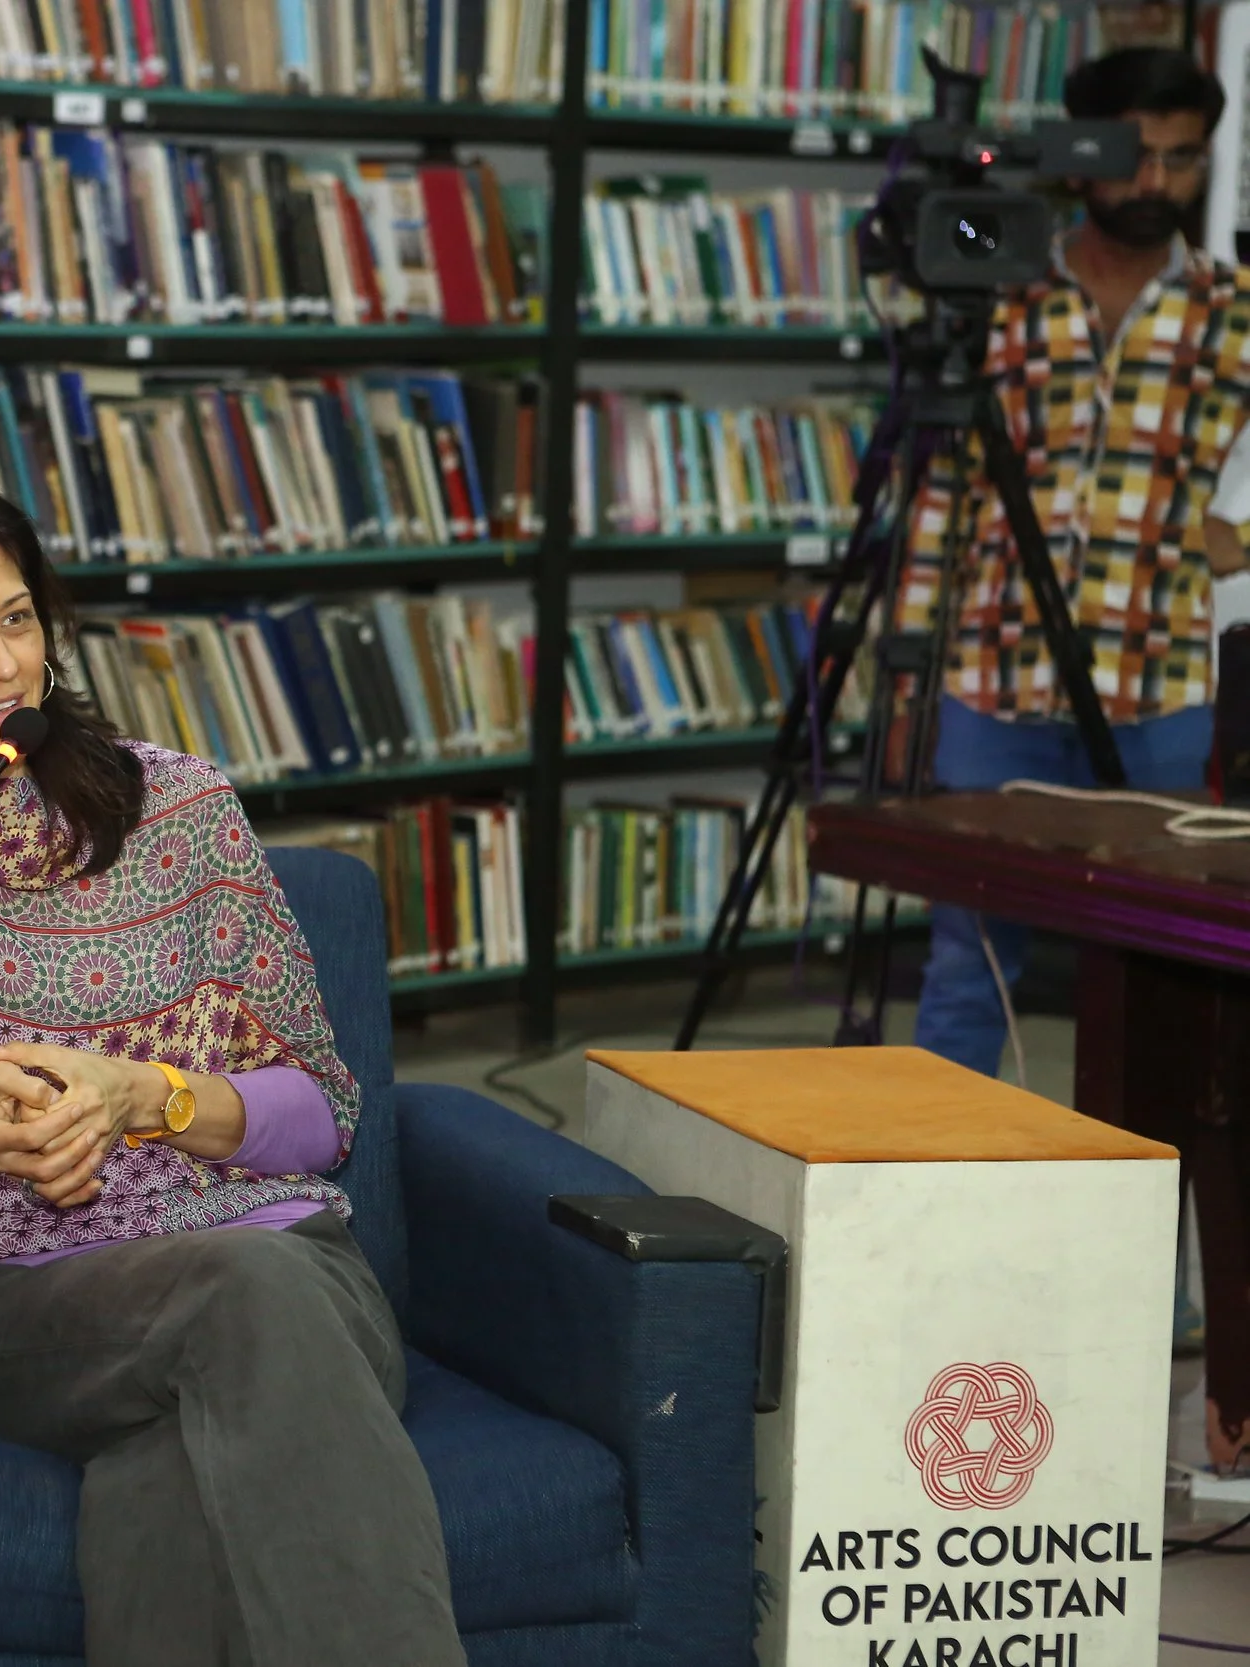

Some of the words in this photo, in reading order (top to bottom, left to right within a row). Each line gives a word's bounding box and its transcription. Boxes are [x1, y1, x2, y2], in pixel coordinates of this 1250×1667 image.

[800, 1529, 920, 1572] ARTS
[937, 1523, 1152, 1567] COUNCIL
[822, 1585, 887, 1626] OF
[904, 1577, 1126, 1623] PAKISTAN
[869, 1633, 1077, 1667] KARACHI
